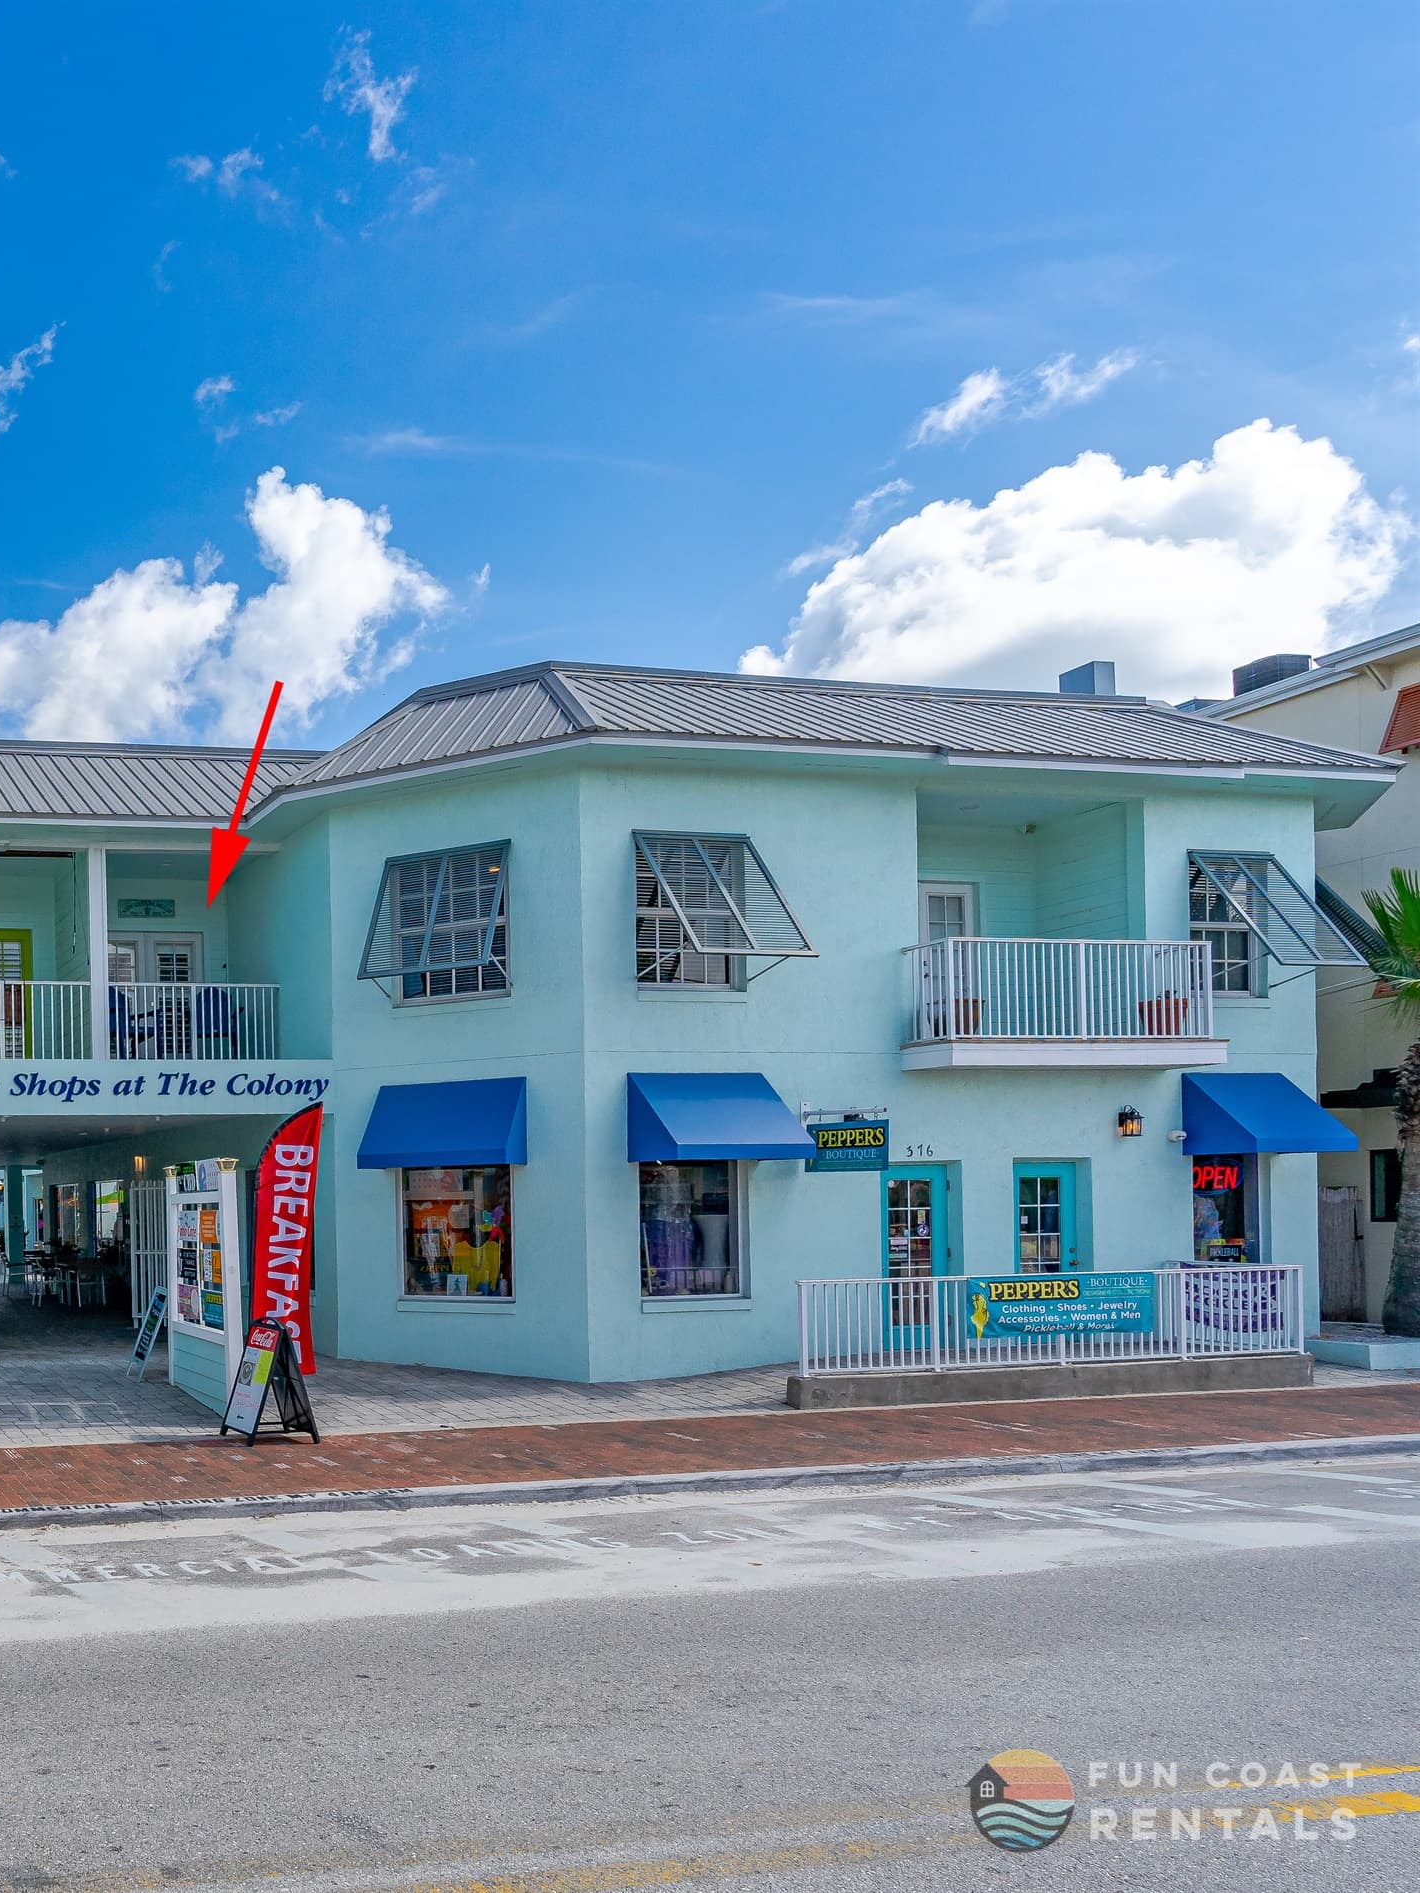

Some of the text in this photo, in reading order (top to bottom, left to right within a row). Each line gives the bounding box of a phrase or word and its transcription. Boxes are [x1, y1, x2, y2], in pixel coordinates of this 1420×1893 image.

[9, 1072, 100, 1103] Shops
[113, 1075, 144, 1097] at
[157, 1071, 216, 1097] The
[226, 1072, 329, 1102] Colony
[825, 1149, 877, 1160] BOUTIQUE
[1192, 1166, 1238, 1190] OPEN
[1090, 1276, 1145, 1287] BOUTIQUE
[1002, 1301, 1137, 1314] Clothing Shoes Jewelry
[997, 1311, 1141, 1324] Accessories Women & Men
[1023, 1323, 1075, 1333] Pickleball
